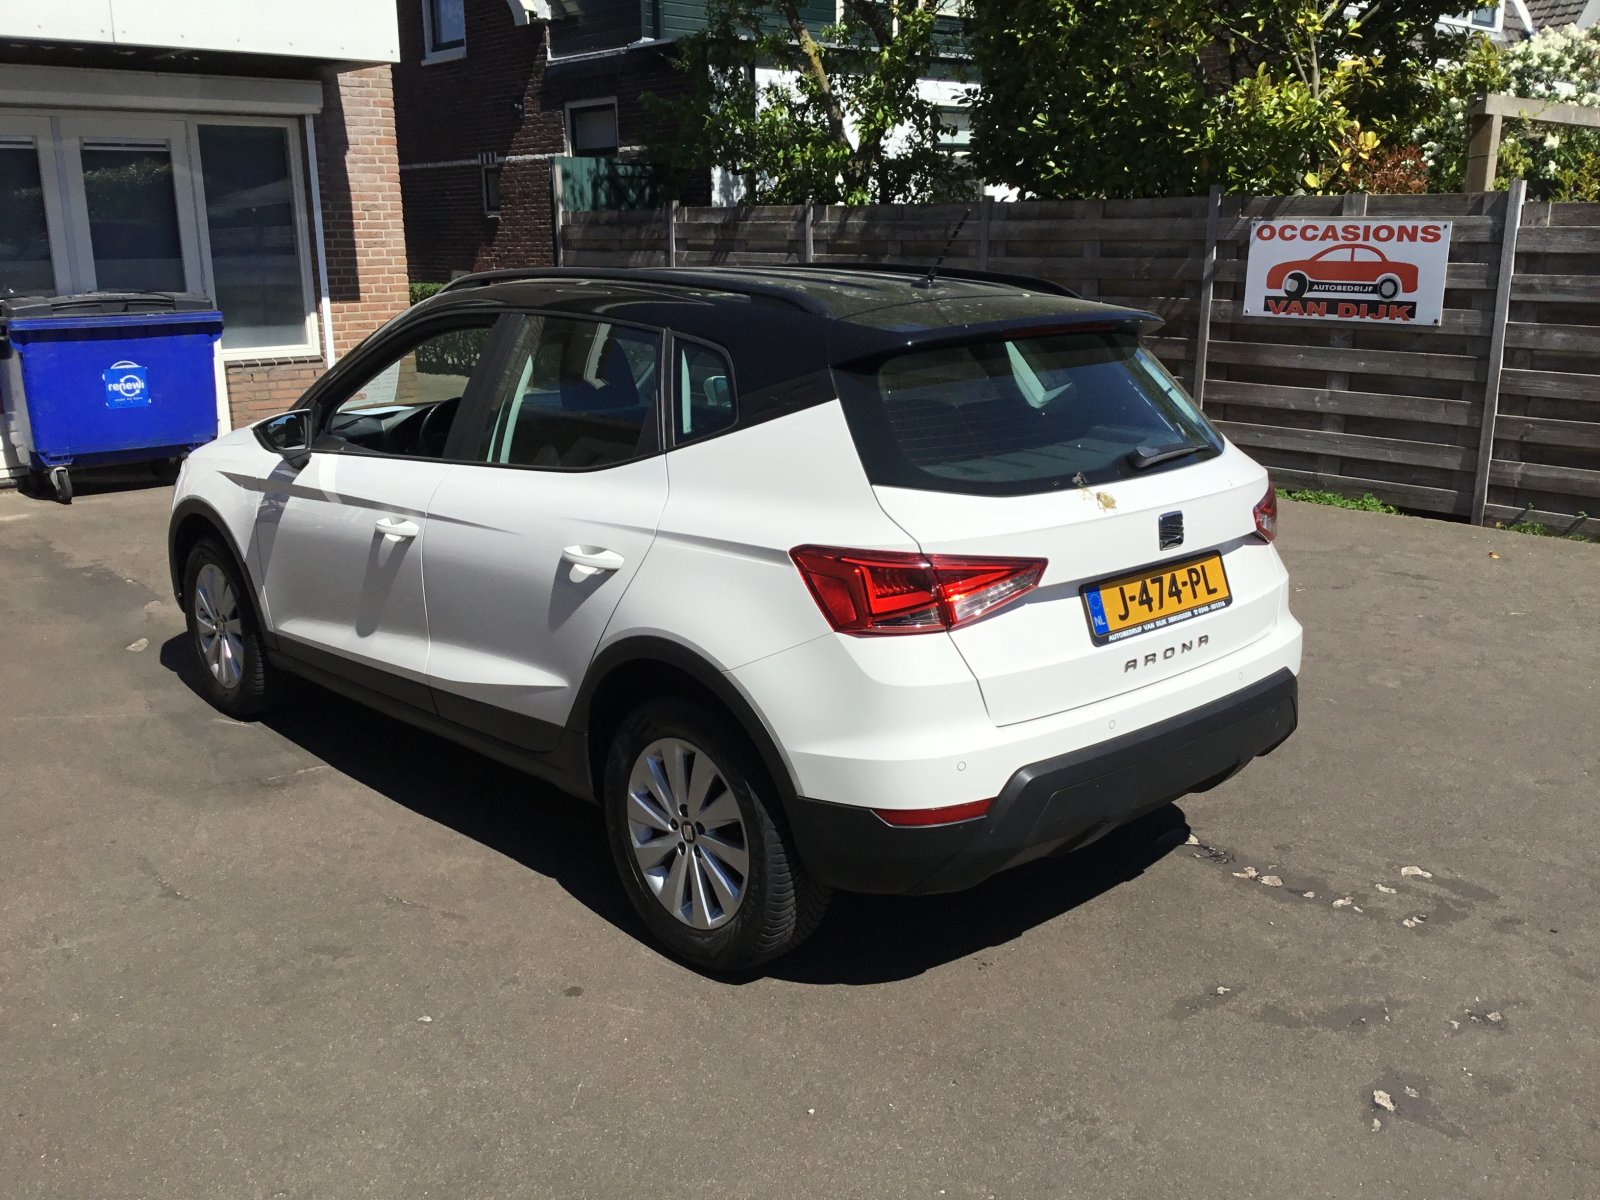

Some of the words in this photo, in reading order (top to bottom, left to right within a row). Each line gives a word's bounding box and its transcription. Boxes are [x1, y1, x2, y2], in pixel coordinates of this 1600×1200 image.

[1256, 224, 1442, 243] OCCASIONS
[1312, 284, 1374, 293] AUTOBEDRIJF
[1266, 300, 1328, 317] VAN
[1337, 303, 1413, 321] DIJK
[108, 379, 145, 392] renewi
[1118, 565, 1218, 621] J-474-PL
[1093, 615, 1106, 627] NL
[1108, 626, 1142, 642] AUTOBEDRIJF
[1143, 622, 1155, 631] VAN
[1124, 634, 1209, 673] ARONA
